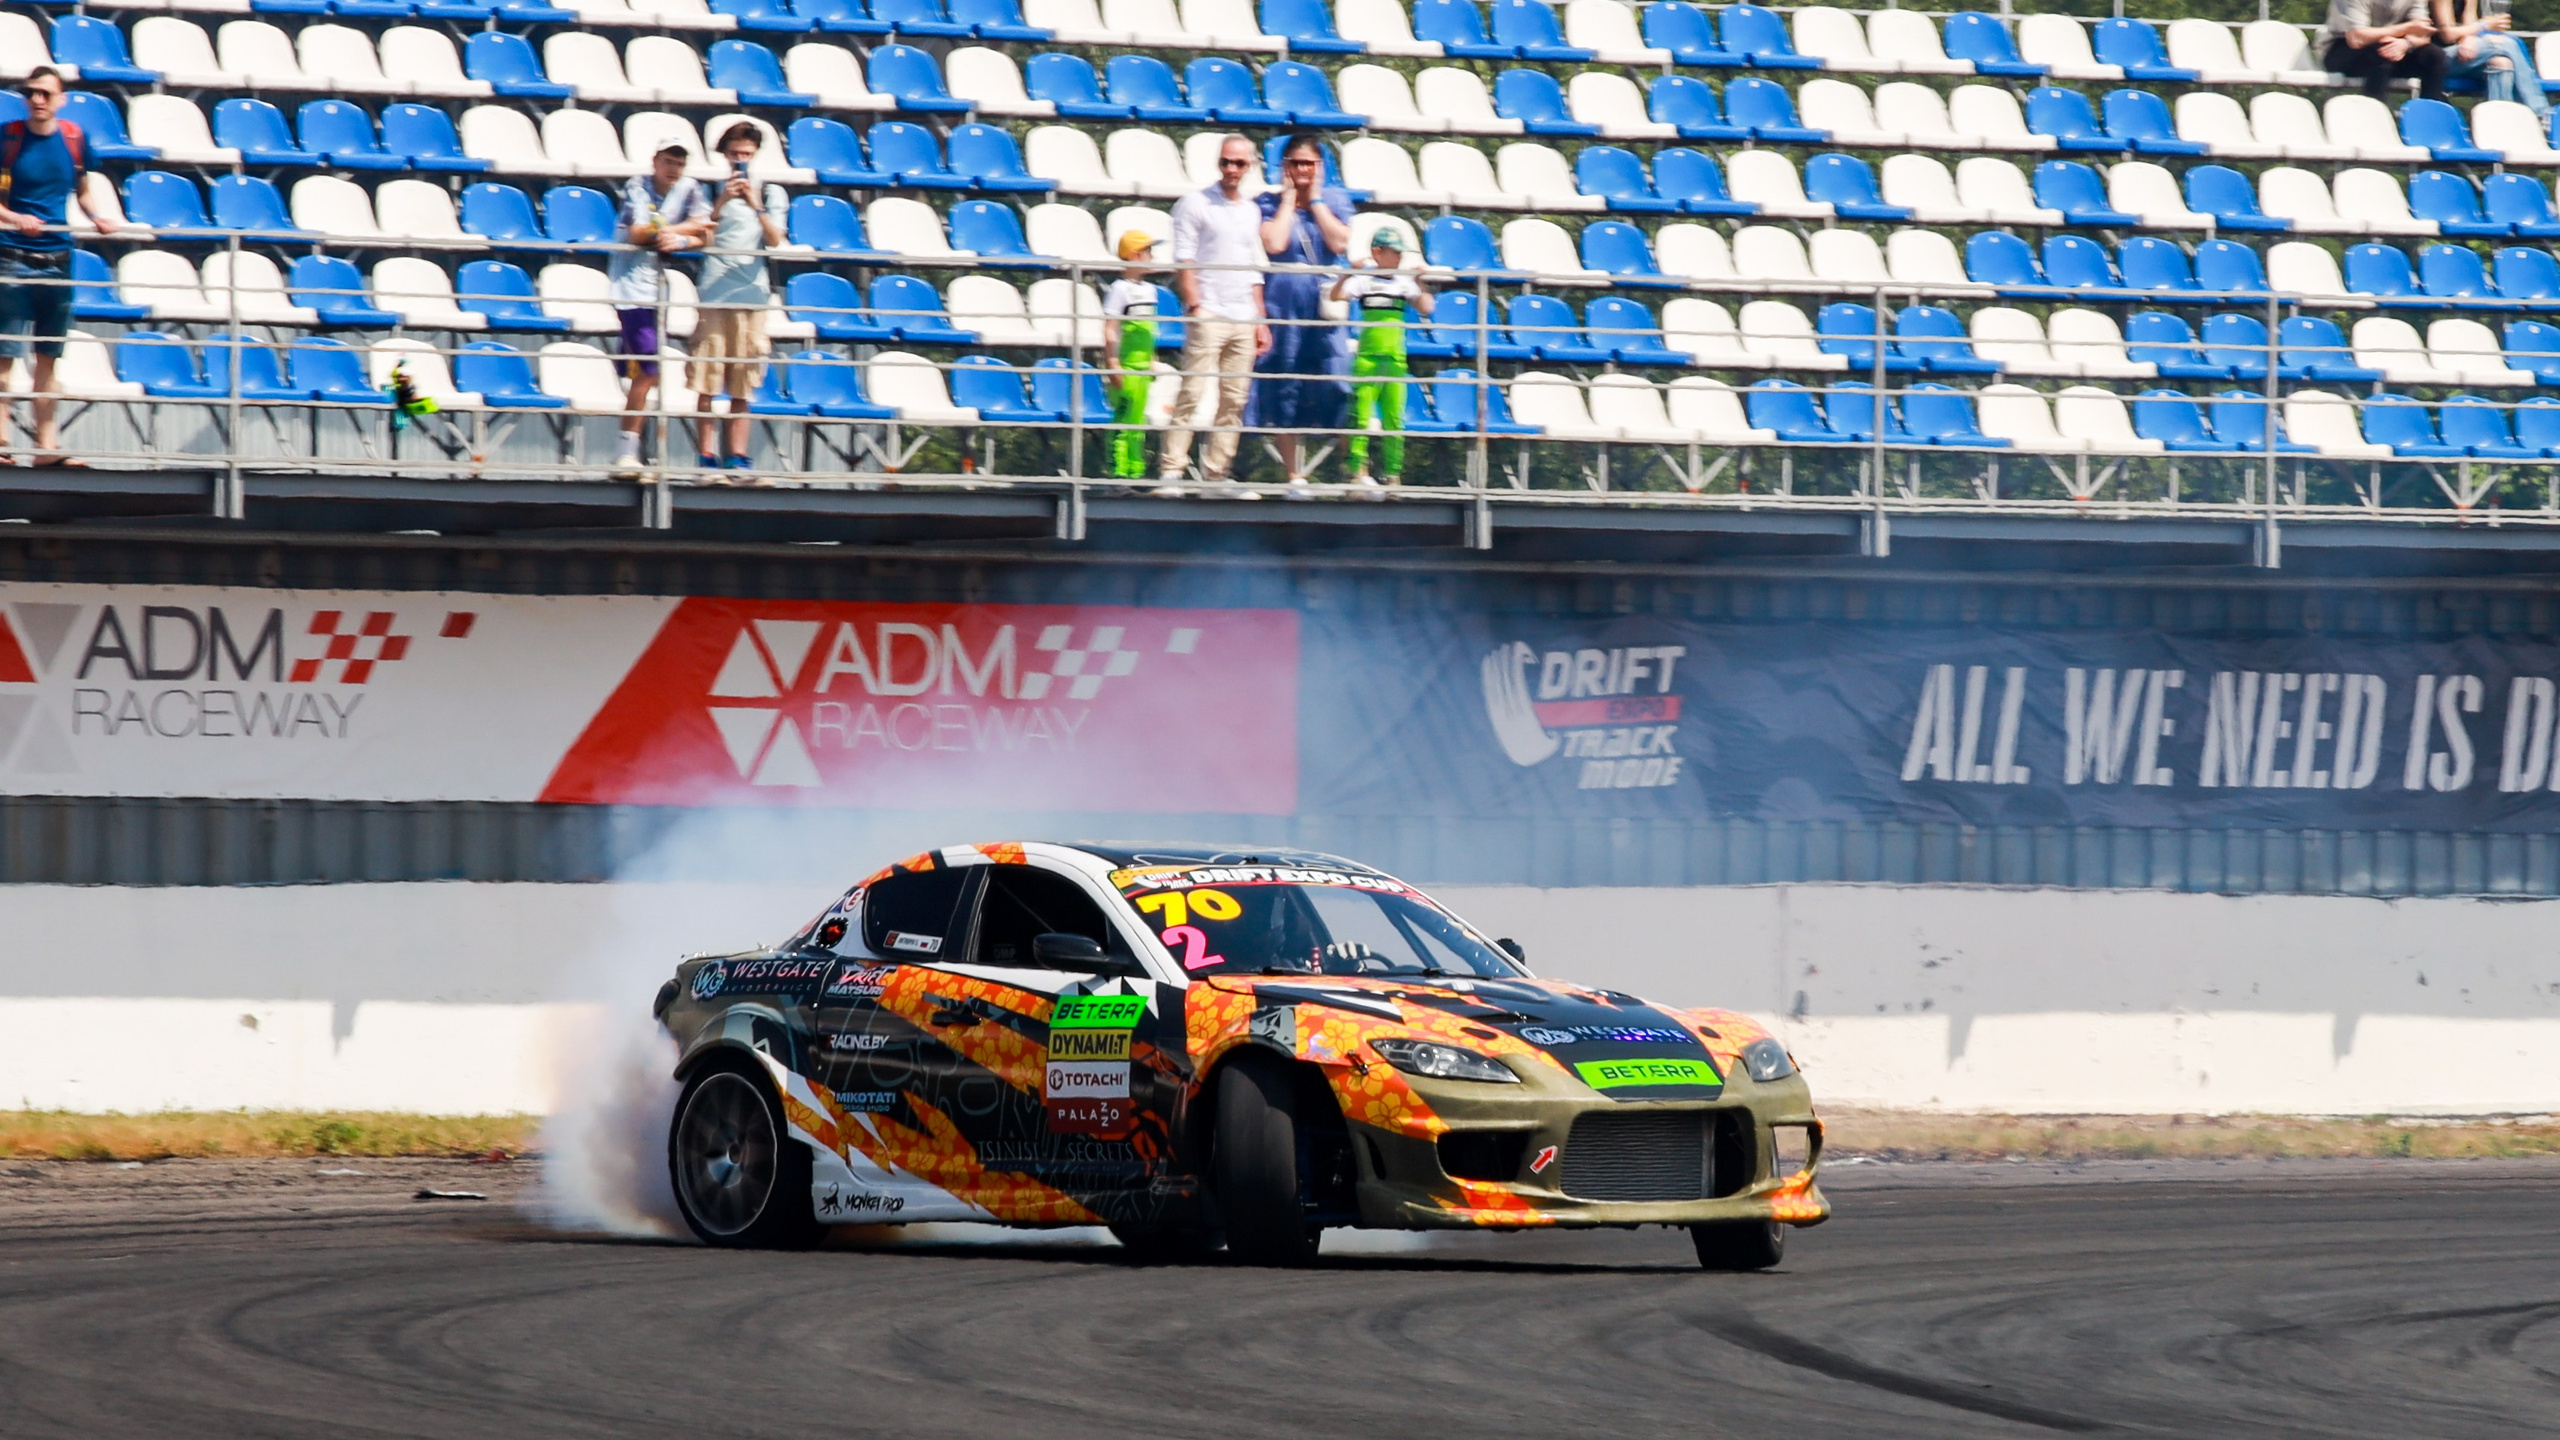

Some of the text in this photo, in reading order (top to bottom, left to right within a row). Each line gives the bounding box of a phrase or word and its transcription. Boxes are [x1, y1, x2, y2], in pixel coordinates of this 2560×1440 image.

[76, 604, 286, 682] ADM
[814, 620, 1018, 699] ADM
[1538, 645, 1687, 699] DRIFT
[71, 688, 365, 738] RACEWAY
[810, 701, 1091, 751] RACEWAY
[1901, 663, 2031, 786] ALL
[2064, 667, 2186, 788] WE
[2199, 671, 2388, 790] NEED
[2403, 674, 2484, 792] IS
[1190, 868, 1405, 894] DRIFT EXPO CUP
[1136, 888, 1243, 928] 70
[1161, 924, 1226, 971] 2
[732, 960, 827, 978] WESTGATE
[826, 985, 886, 995] MATSURI
[1568, 1025, 1687, 1040] WESTGATE
[1065, 1073, 1124, 1087] TOTACHI
[1599, 1064, 1699, 1080] BETERA
[836, 1091, 897, 1104] MIKOTATI
[843, 1104, 890, 1112] DESIGN STUDIO
[1066, 1141, 1135, 1162] SECRETS
